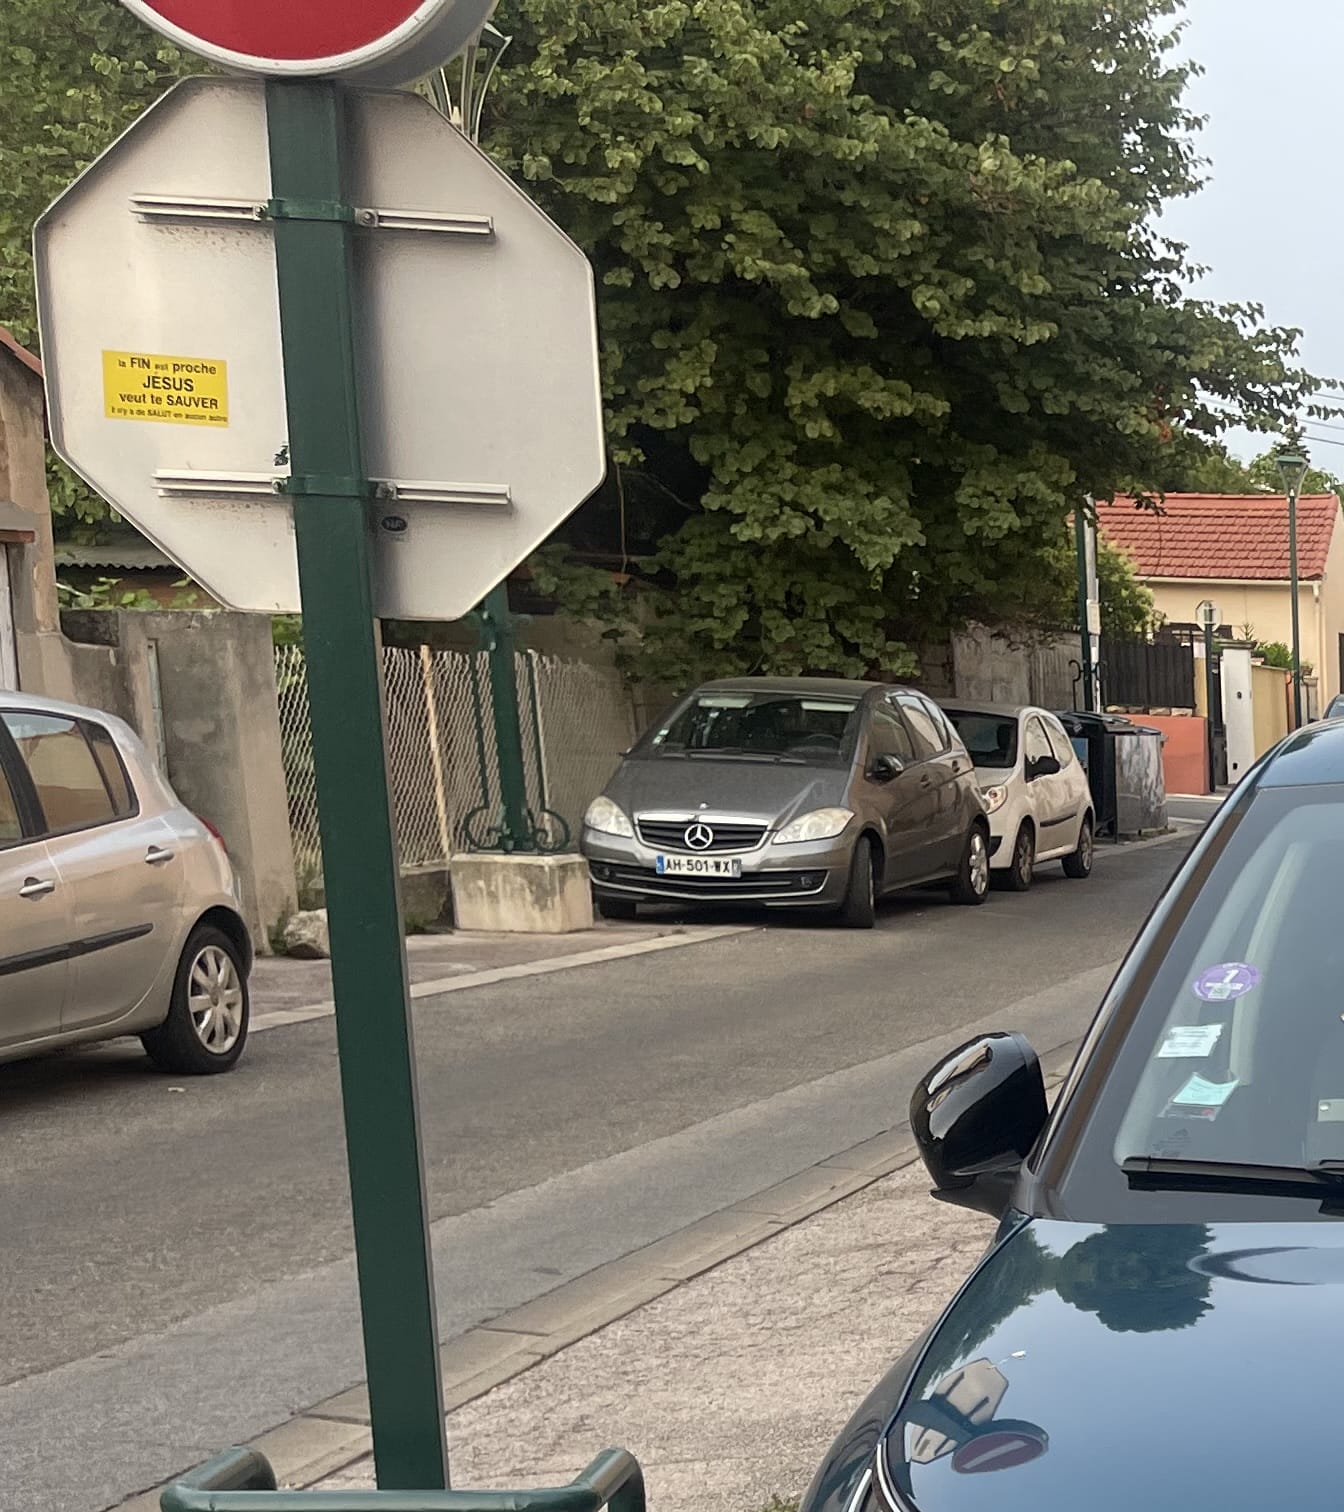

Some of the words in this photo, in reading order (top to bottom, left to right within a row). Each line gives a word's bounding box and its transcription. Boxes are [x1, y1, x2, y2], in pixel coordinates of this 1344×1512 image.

[118, 359, 126, 368] la
[130, 357, 151, 370] FIN
[172, 362, 217, 375] proche
[118, 392, 147, 404] veut
[150, 393, 163, 406] te
[166, 394, 219, 410] SAUVER
[147, 408, 172, 418] SALUT
